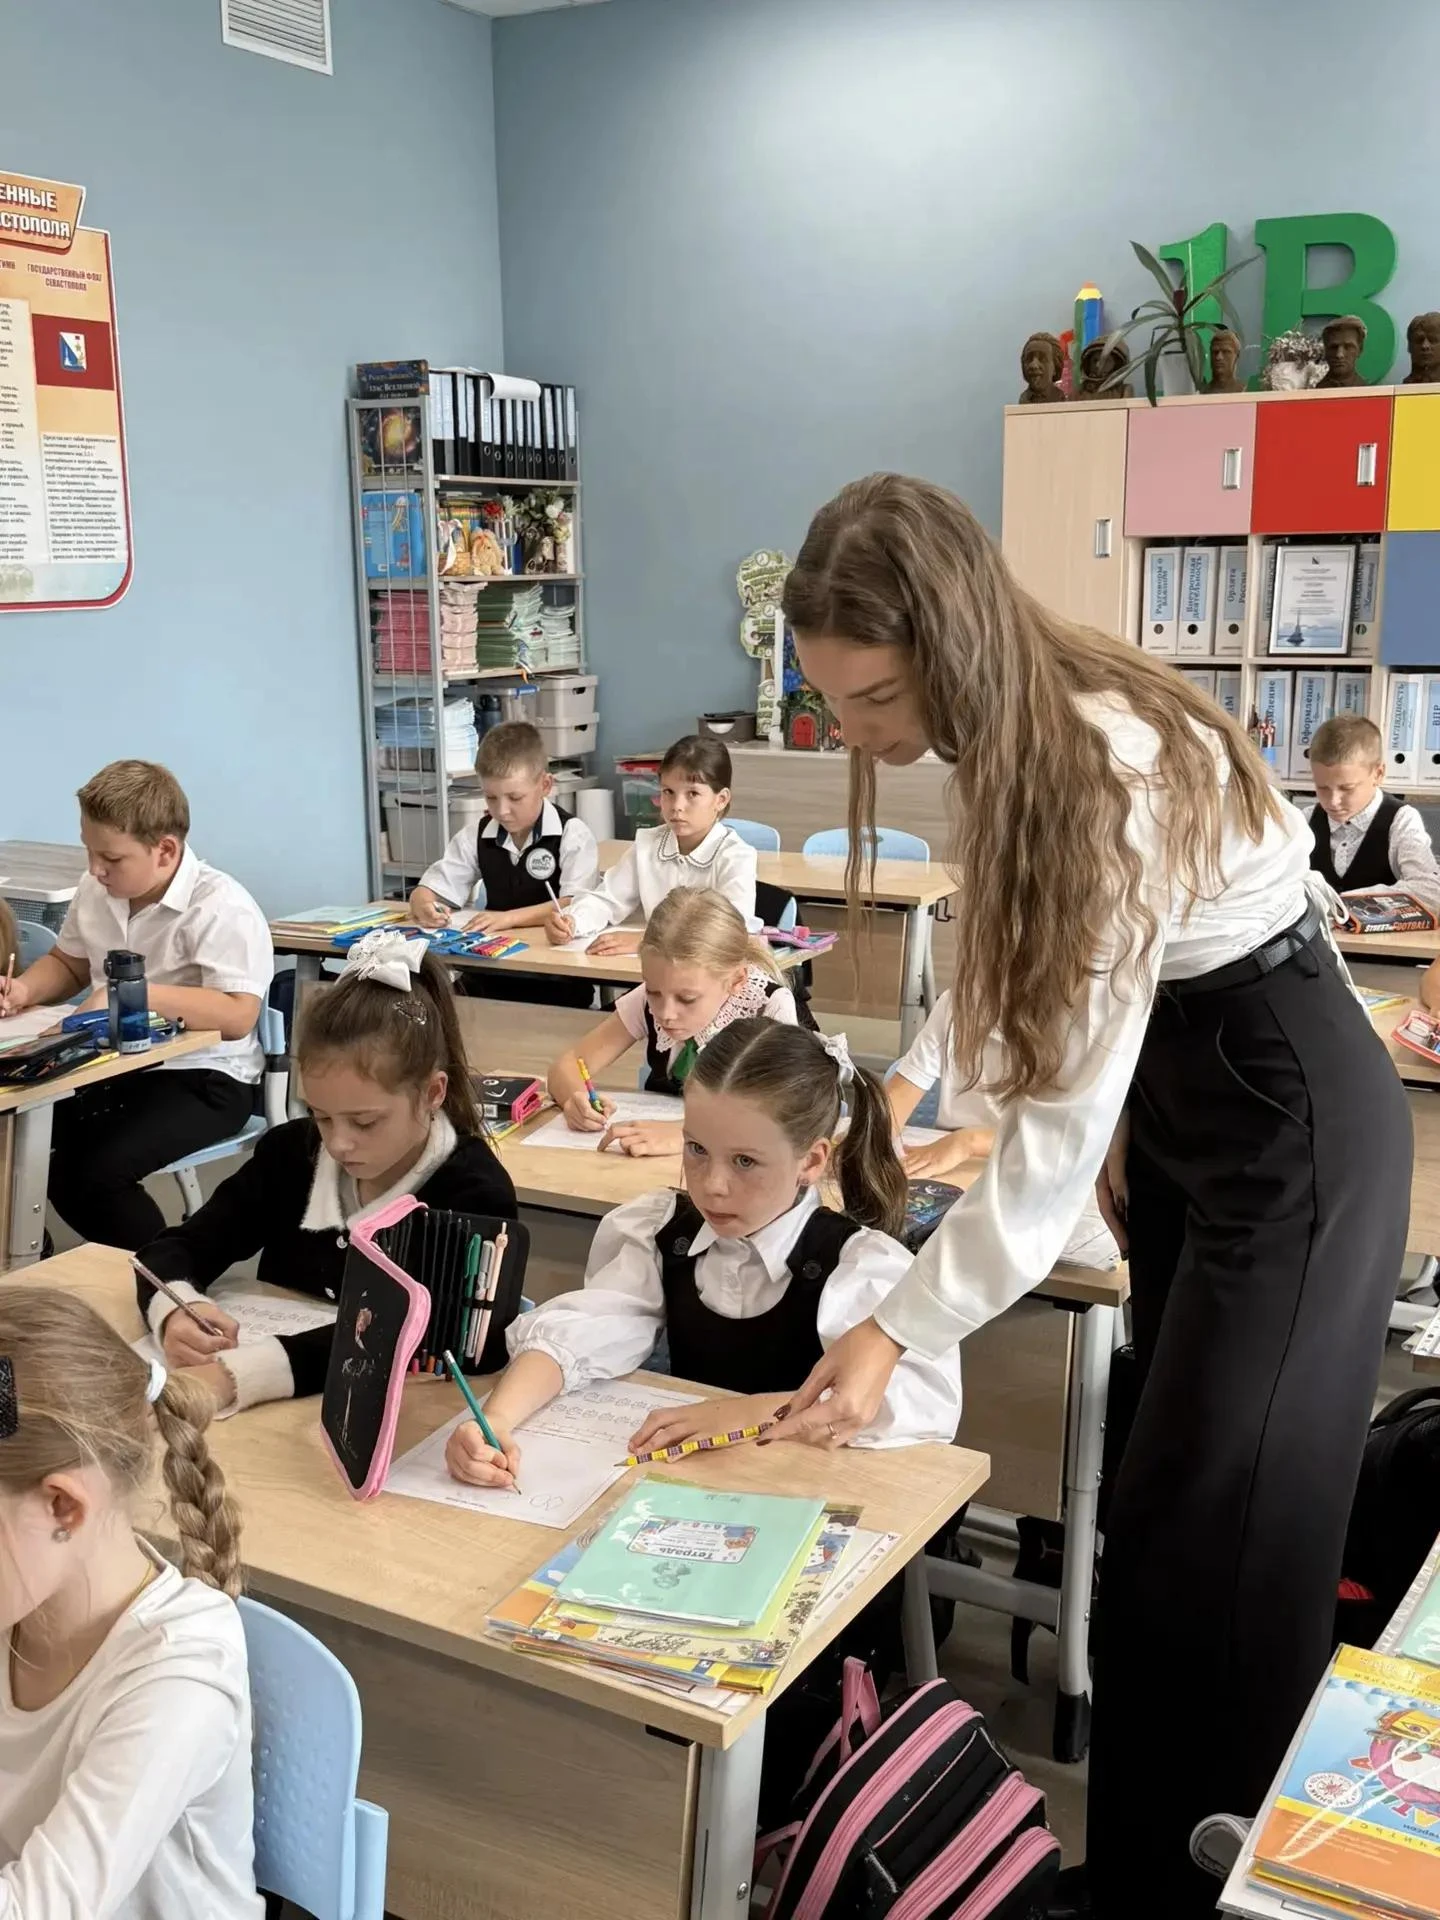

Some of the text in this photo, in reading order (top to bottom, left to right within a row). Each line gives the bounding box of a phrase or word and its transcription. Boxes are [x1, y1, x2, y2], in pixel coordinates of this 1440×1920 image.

[0, 211, 71, 238] СТОПОЛЯ
[1301, 678, 1314, 744] Оформление
[659, 1546, 714, 1560] Тетрадь
